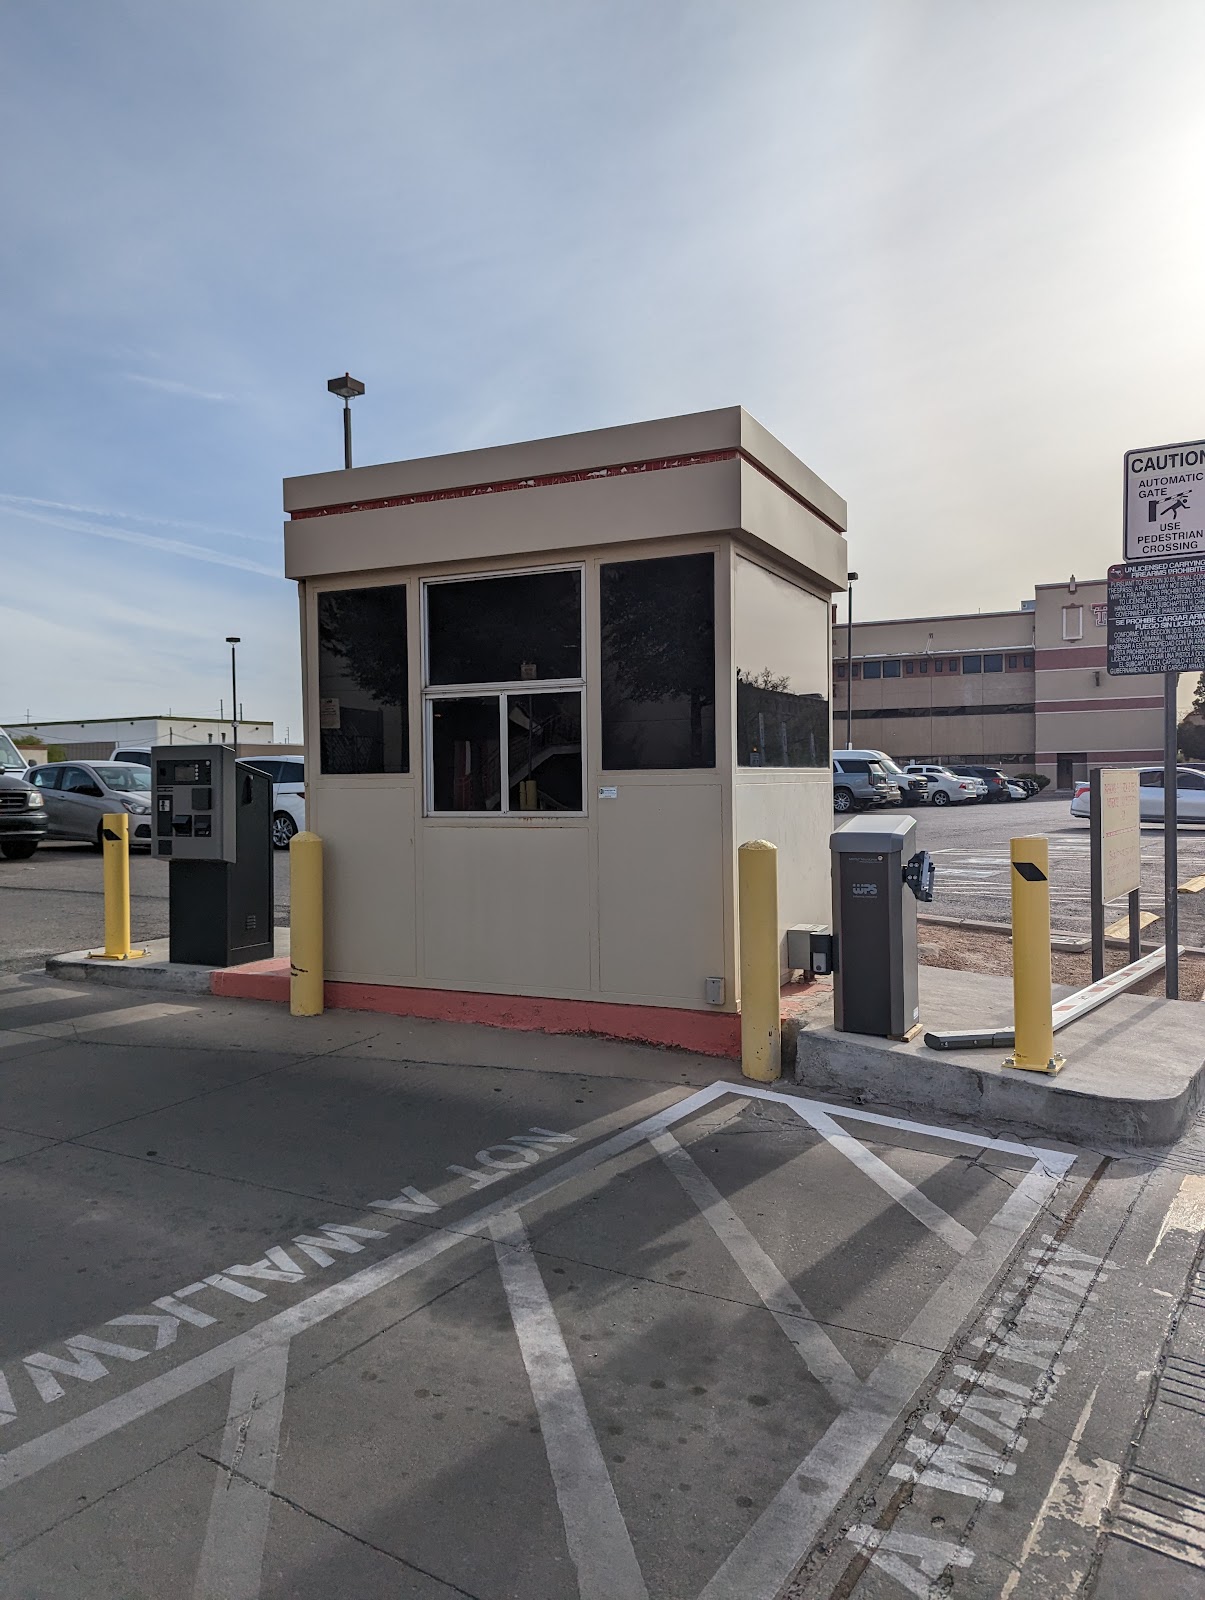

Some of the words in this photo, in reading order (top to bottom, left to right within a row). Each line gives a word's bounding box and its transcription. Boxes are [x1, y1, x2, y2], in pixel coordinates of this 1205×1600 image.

[1138, 472, 1204, 488] AUTOMATIC
[1138, 488, 1168, 498] GATE
[1160, 522, 1181, 532] USE
[1137, 530, 1204, 544] PEDESTRIAN
[1142, 541, 1198, 554] CROSSING
[1125, 563, 1168, 573] UNLICENSED
[1170, 560, 1205, 568] CARRYING
[1132, 570, 1166, 578] FIREARMS
[852, 884, 878, 894] WPS
[446, 1127, 579, 1189] NOT
[367, 1186, 441, 1214] A
[0, 1223, 389, 1427] WALKW
[888, 1233, 1125, 1503] WALKWAY
[845, 1523, 976, 1600] A
